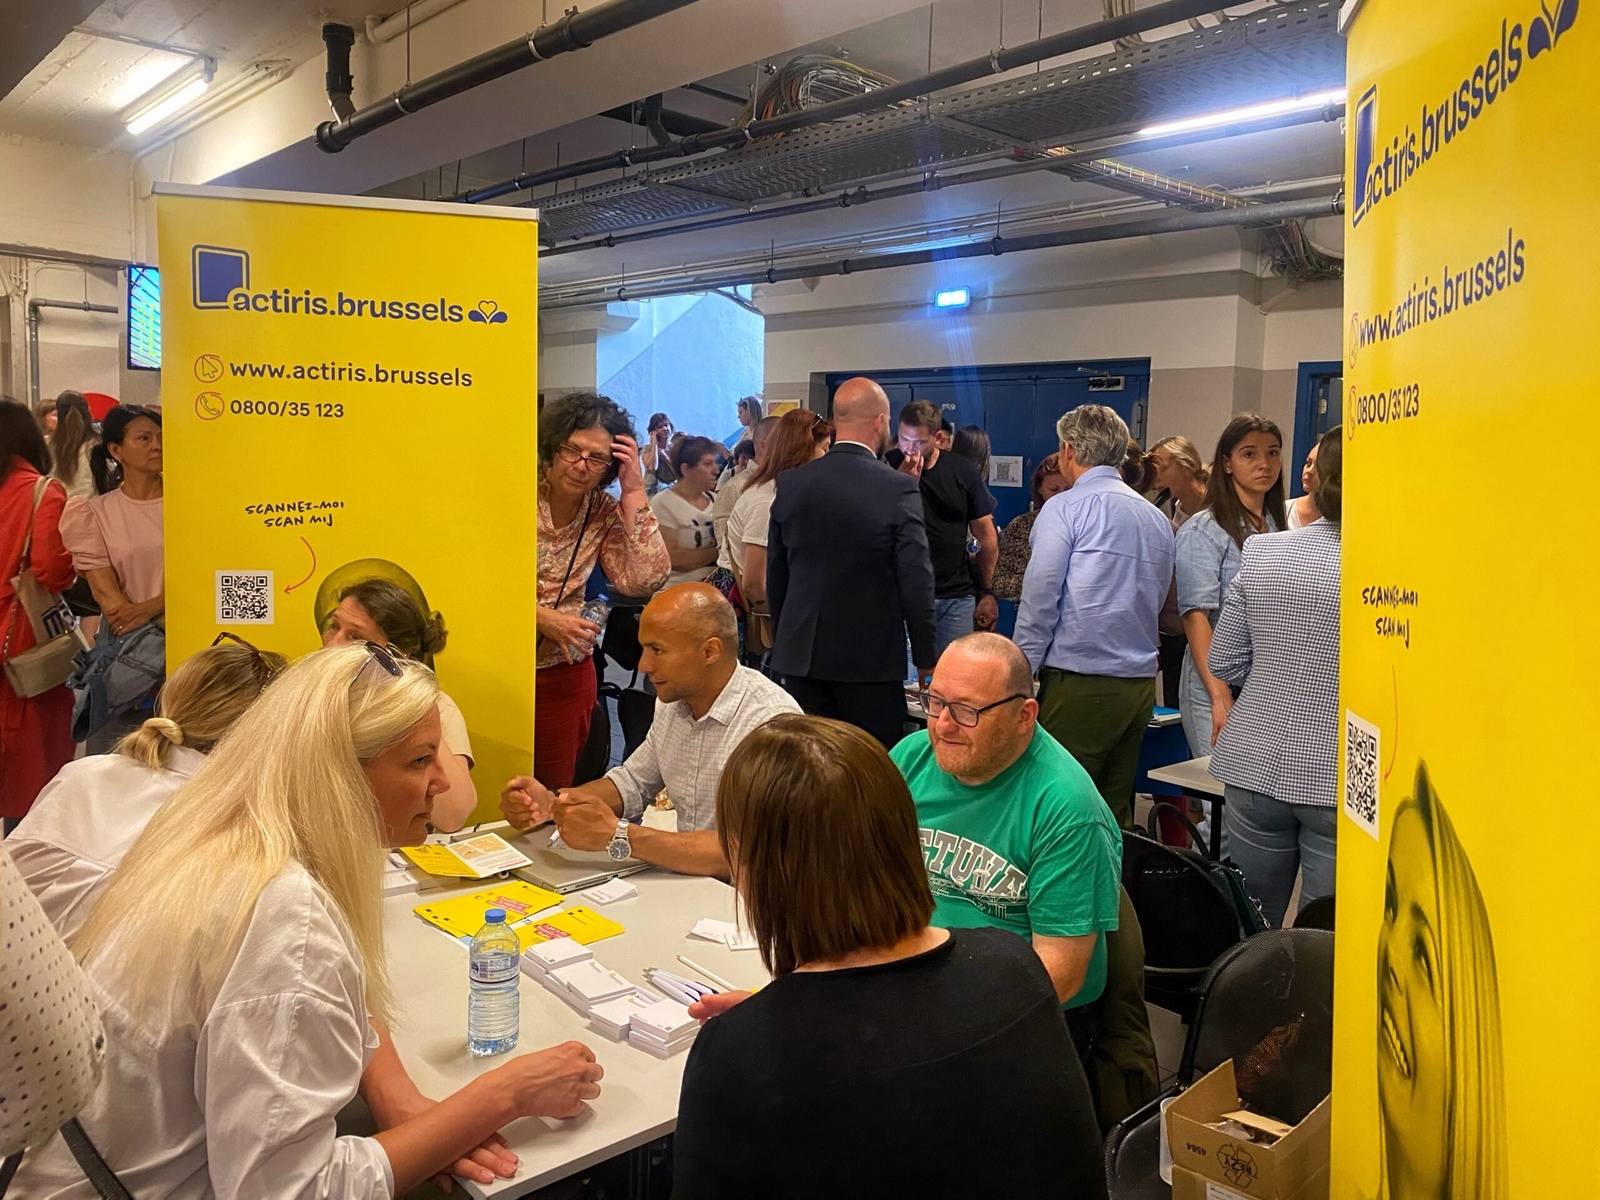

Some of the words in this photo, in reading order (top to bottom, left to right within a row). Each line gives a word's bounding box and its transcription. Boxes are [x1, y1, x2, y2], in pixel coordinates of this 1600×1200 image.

[1365, 18, 1523, 213] actiris.brussels
[1359, 227, 1526, 348] www.actiris.brussels
[232, 288, 464, 323] actiris.brussels
[229, 361, 473, 387] www.actiris.brussels
[230, 399, 310, 417] 0800/35
[315, 402, 344, 418] 123
[244, 500, 344, 514] SCANNEZ-MOI
[264, 515, 304, 527] SCAN
[309, 513, 333, 527] MIJ
[1224, 1154, 1252, 1175] REZY
